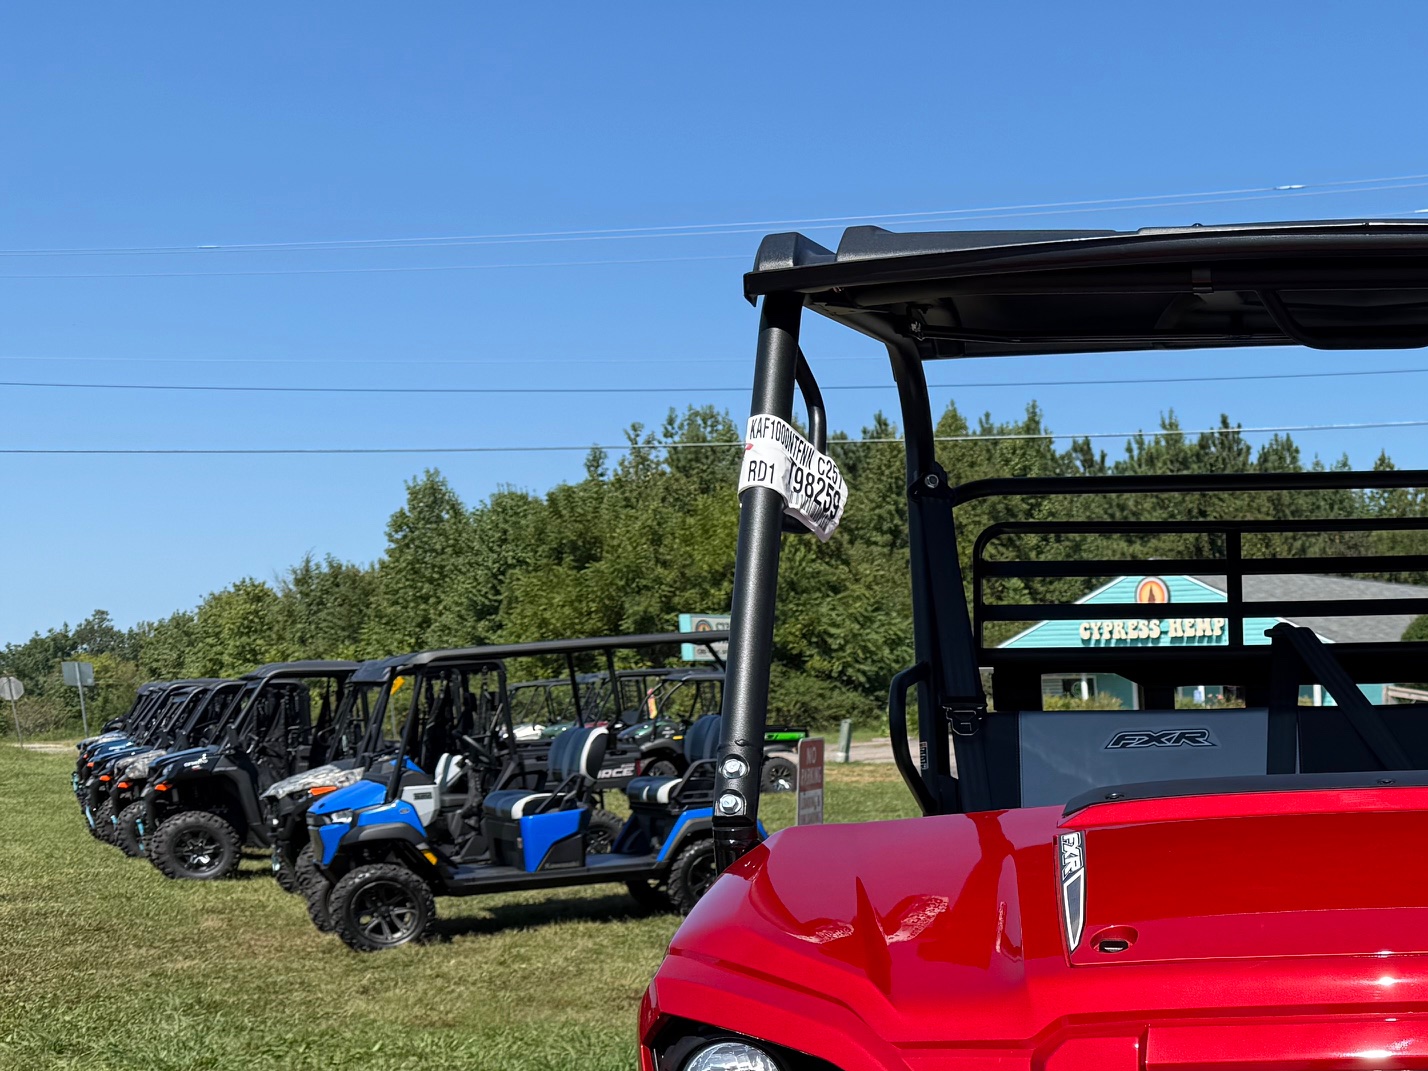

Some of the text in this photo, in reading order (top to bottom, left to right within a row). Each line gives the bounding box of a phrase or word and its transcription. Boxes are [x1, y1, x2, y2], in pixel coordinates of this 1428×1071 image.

[748, 460, 775, 484] RD1
[789, 456, 841, 519] T98259
[1079, 617, 1225, 640] CYPRESS HEMP
[1104, 729, 1217, 749] FXR
[1061, 832, 1083, 880] FXR
